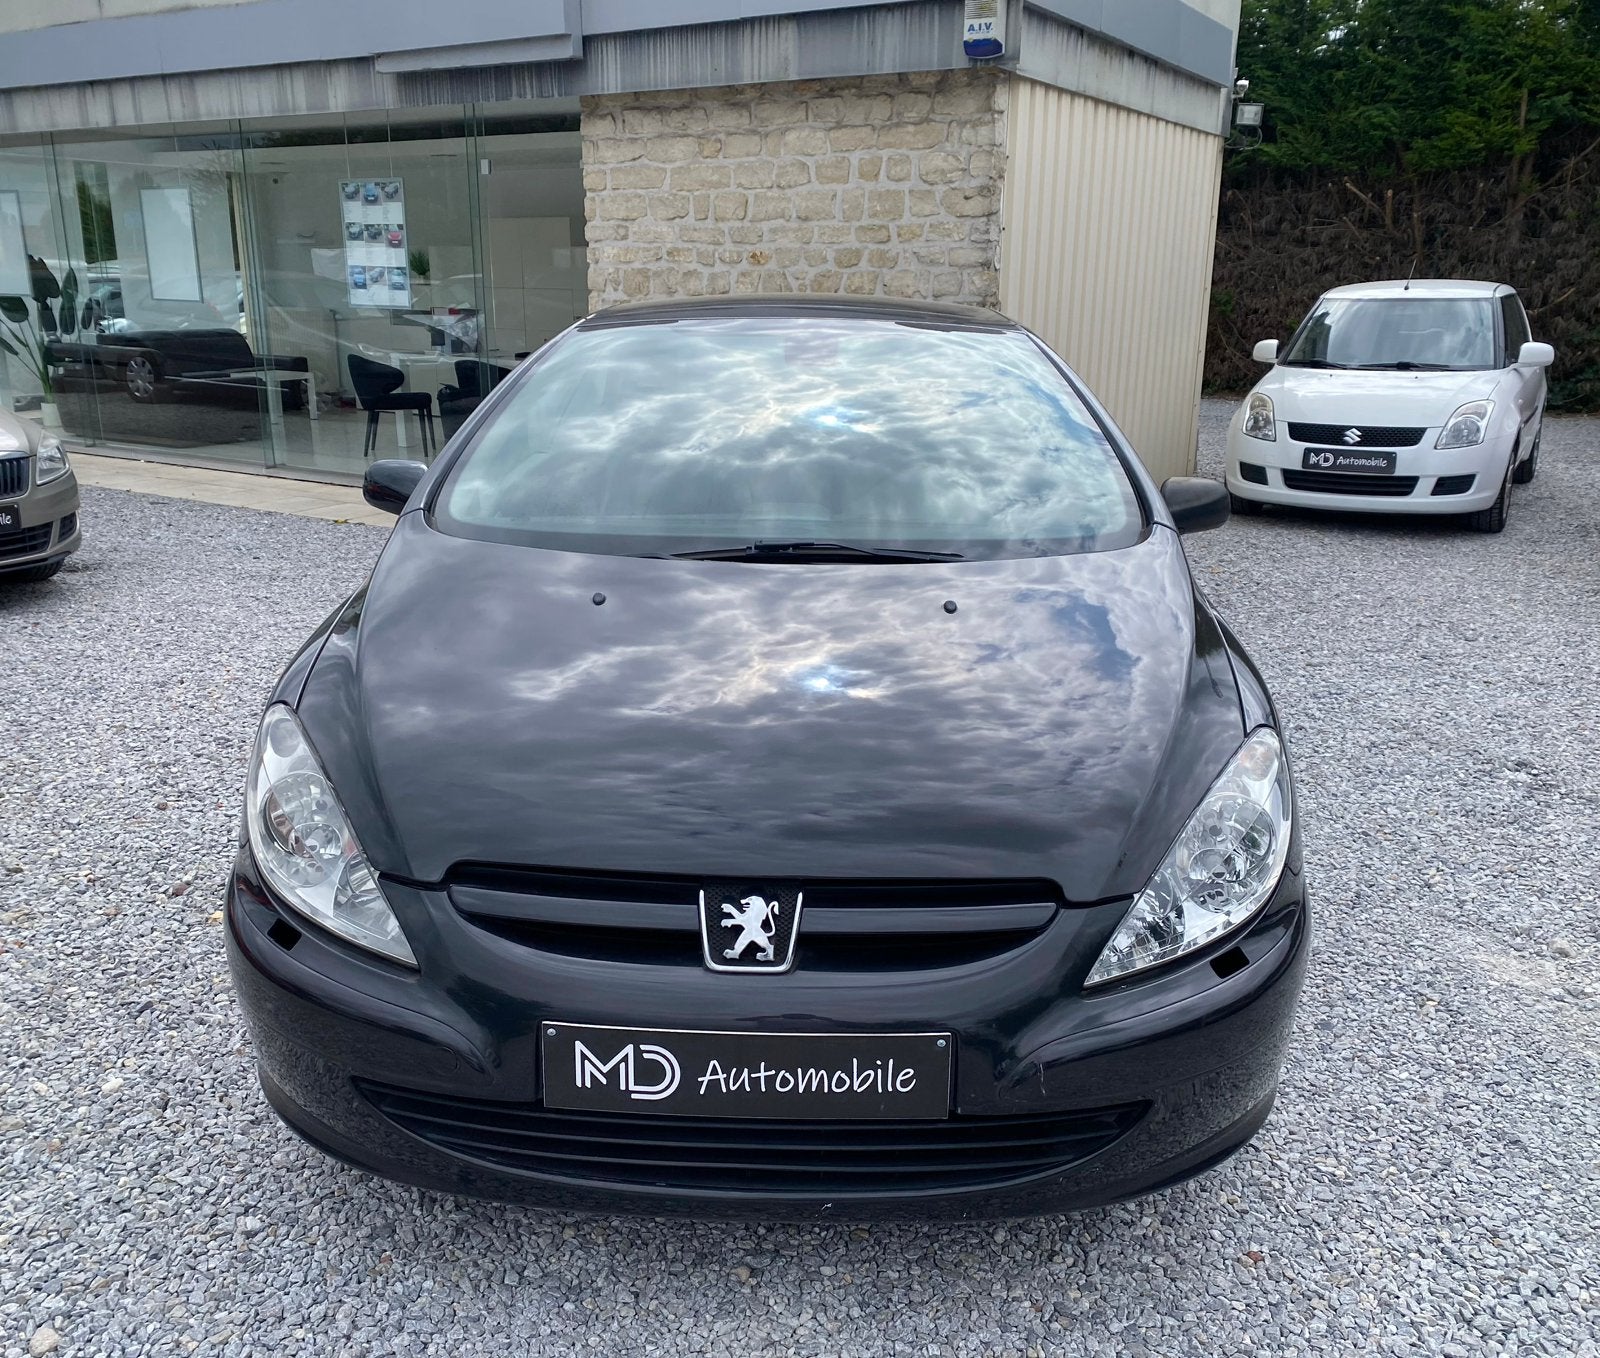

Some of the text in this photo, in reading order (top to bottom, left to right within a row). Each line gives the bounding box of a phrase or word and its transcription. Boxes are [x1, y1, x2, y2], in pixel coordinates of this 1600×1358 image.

[967, 22, 993, 32] A.I.V.
[1309, 452, 1388, 467] MD Automobile
[575, 1040, 917, 1100] MD Automobile
